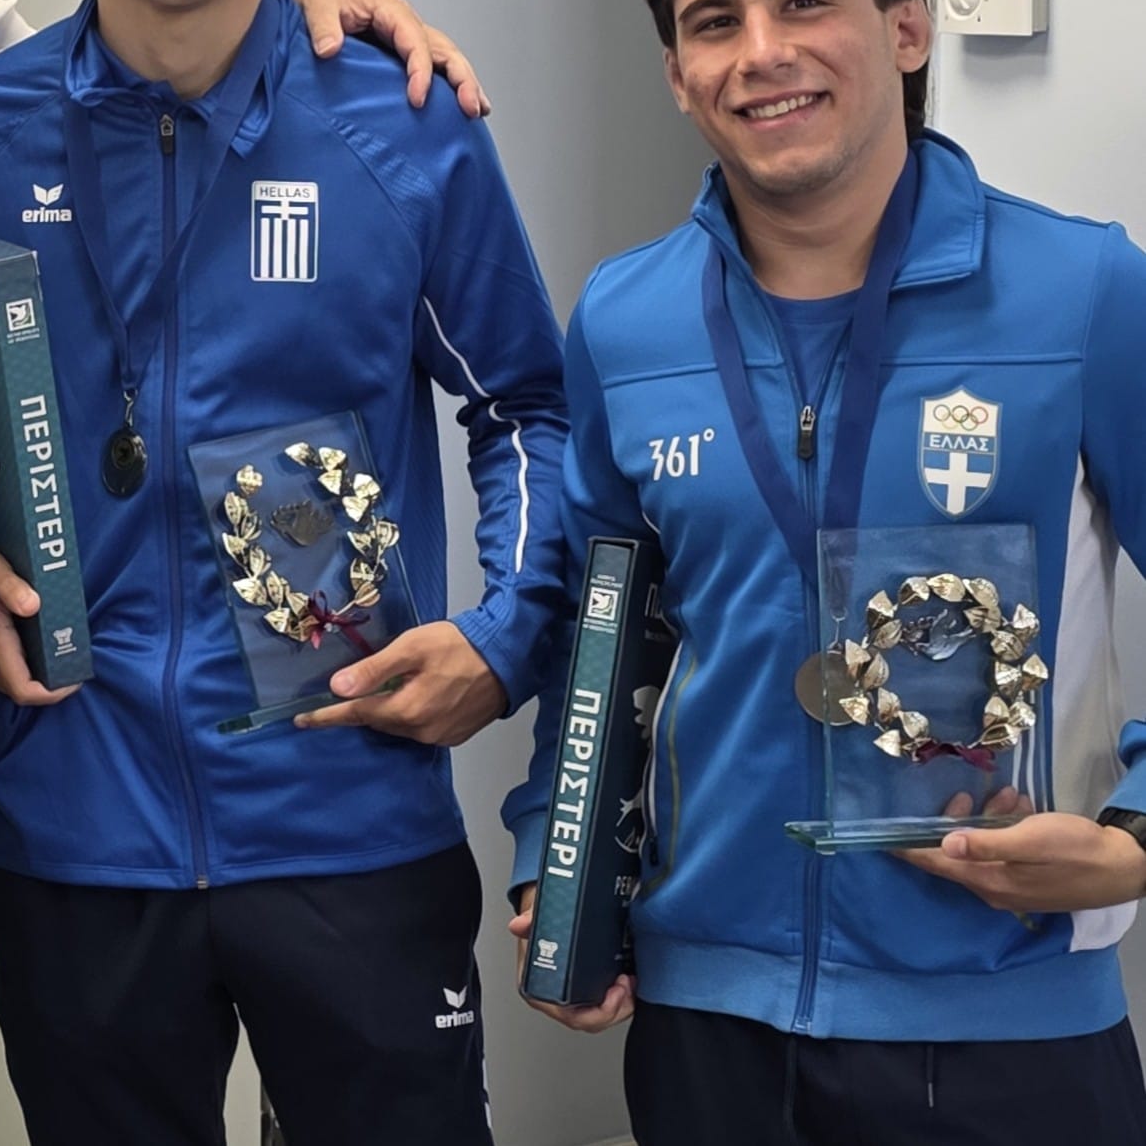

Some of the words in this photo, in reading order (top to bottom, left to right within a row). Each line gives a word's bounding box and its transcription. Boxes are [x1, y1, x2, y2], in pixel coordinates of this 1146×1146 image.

[259, 186, 311, 199] HELLAS
[21, 206, 72, 223] erima
[929, 434, 989, 452] ΕΛΛΑΣ
[20, 394, 68, 572] ΠΕΡΙΣΤΕΡΙ
[547, 688, 602, 879] ΠΕΡΙΣΤΕΡΙ
[435, 1010, 474, 1028] erima
